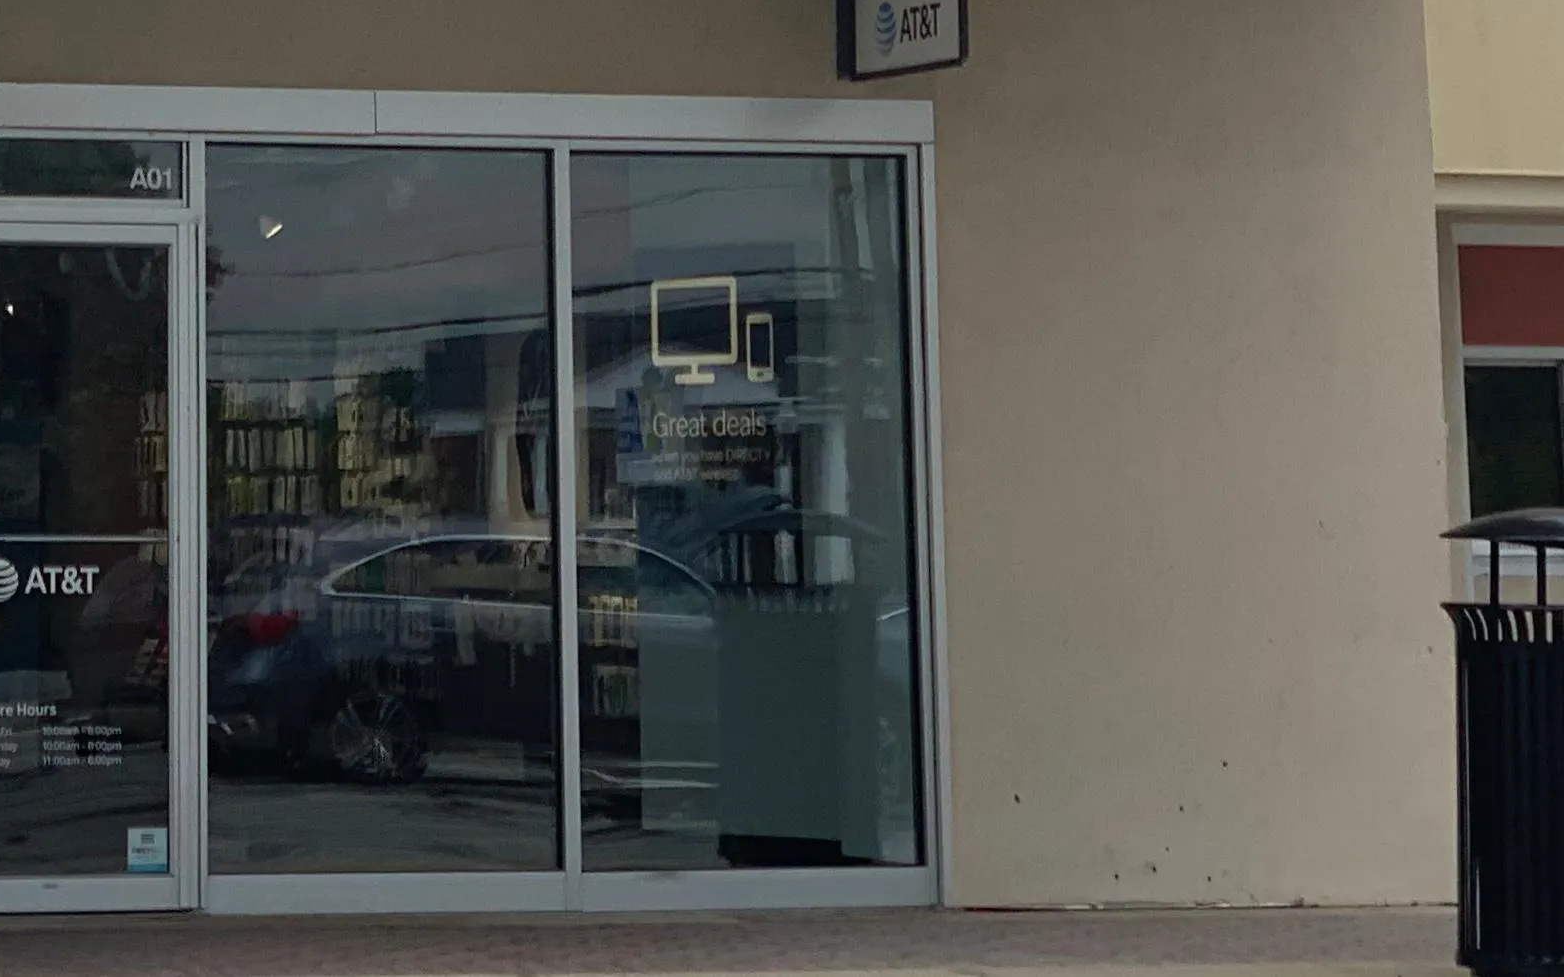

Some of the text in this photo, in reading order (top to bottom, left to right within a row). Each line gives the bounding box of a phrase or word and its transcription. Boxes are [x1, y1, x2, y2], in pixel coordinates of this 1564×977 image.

[899, 2, 941, 43] AT&T
[130, 168, 172, 190] A01
[653, 408, 766, 438] Great deals
[24, 566, 100, 594] AT&T
[16, 703, 57, 717] Hours
